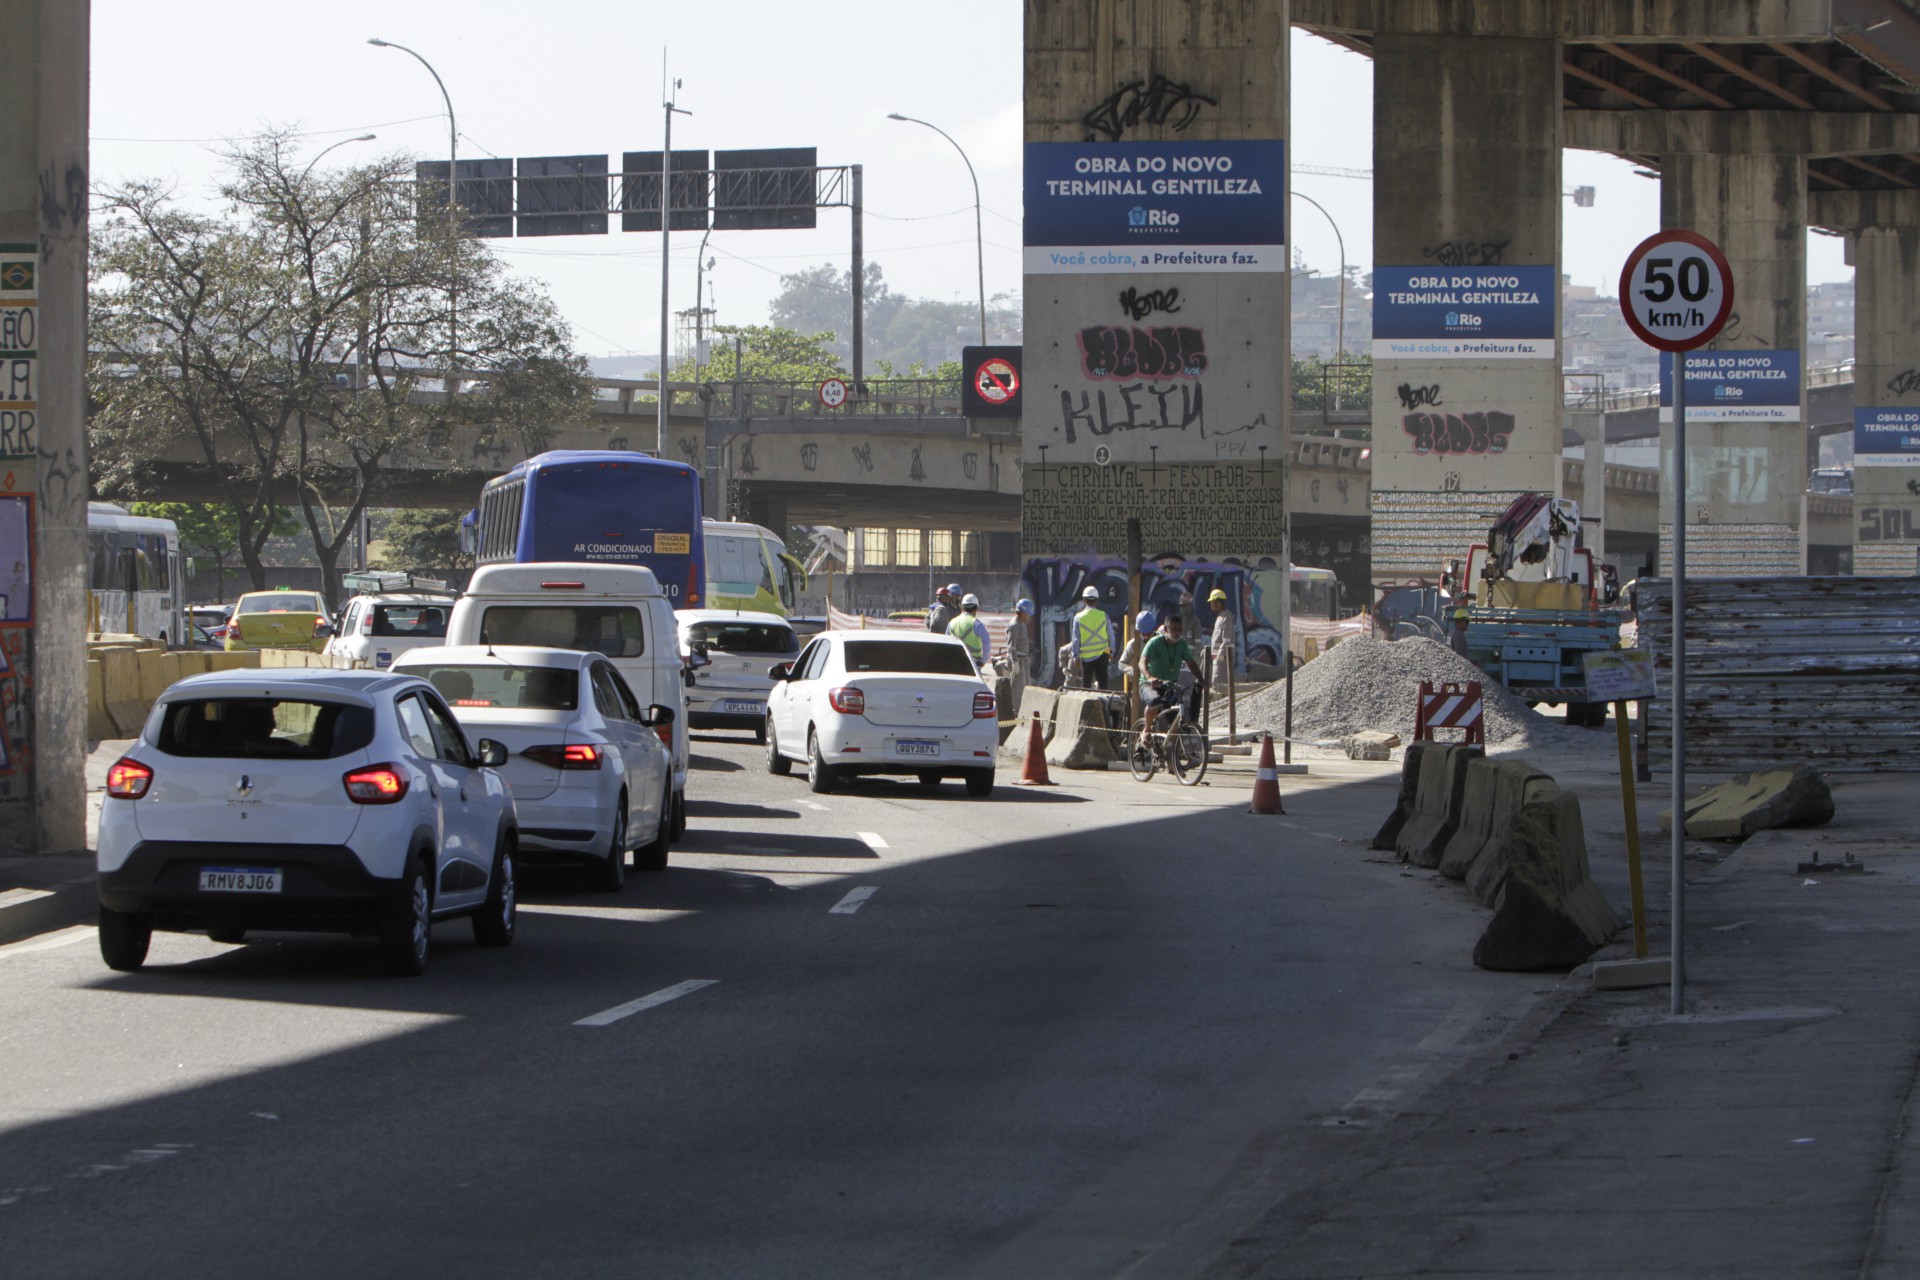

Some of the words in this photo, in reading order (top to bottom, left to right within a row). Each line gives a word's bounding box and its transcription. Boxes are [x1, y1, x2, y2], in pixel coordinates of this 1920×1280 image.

[1074, 157, 1131, 173] OBRA
[1136, 157, 1166, 172] DO
[1172, 156, 1233, 172] NOVO
[1046, 180, 1147, 196] TERMINAL
[1151, 178, 1262, 195] GENTILEZA
[1148, 209, 1180, 225] Rio
[1050, 252, 1086, 265] Você
[1090, 252, 1136, 268] cobra,
[1140, 255, 1149, 265] a
[1154, 251, 1228, 265] Prefeitura
[1231, 251, 1258, 265] faz.
[1408, 276, 1448, 289] OBRA
[1451, 276, 1473, 288] DO
[1476, 275, 1519, 288] NOVO
[1643, 256, 1710, 303] 50
[1389, 292, 1459, 305] TERMINAL
[1462, 292, 1539, 304] GENTILEZA
[1460, 313, 1482, 326] Rio
[1648, 308, 1705, 329] km/h
[1391, 343, 1416, 354] Você
[1418, 343, 1450, 355] cobra,
[1454, 345, 1460, 353] a
[1463, 343, 1515, 353] Prefeitura
[1518, 343, 1536, 353] faz.
[1686, 359, 1716, 368] OBRA
[1719, 358, 1735, 367] DO
[1738, 358, 1771, 367] NOVO
[1727, 370, 1787, 380] GENTILEZA
[1725, 387, 1743, 396] Rio
[1877, 414, 1903, 422] OBRA
[1864, 424, 1910, 432] TERMINAL
[1057, 464, 1143, 488] CARNAVAL
[1169, 465, 1222, 487] FESTA
[1226, 465, 1245, 487] DA
[1444, 471, 1460, 490] 19
[1023, 489, 1068, 505] CARNE
[1073, 489, 1122, 505] NASCEU
[1126, 489, 1145, 505] NA
[1209, 489, 1225, 504] DE
[1023, 505, 1060, 521] FESTA
[1129, 506, 1161, 521] TODOS
[1022, 521, 1044, 537] HAR
[1048, 521, 1078, 537] COMO
[1113, 521, 1126, 537] DE
[657, 534, 687, 542] DISQUE
[574, 543, 586, 553] AR
[587, 543, 653, 554] CONDICIONADO
[207, 873, 274, 890] RMV8J06
